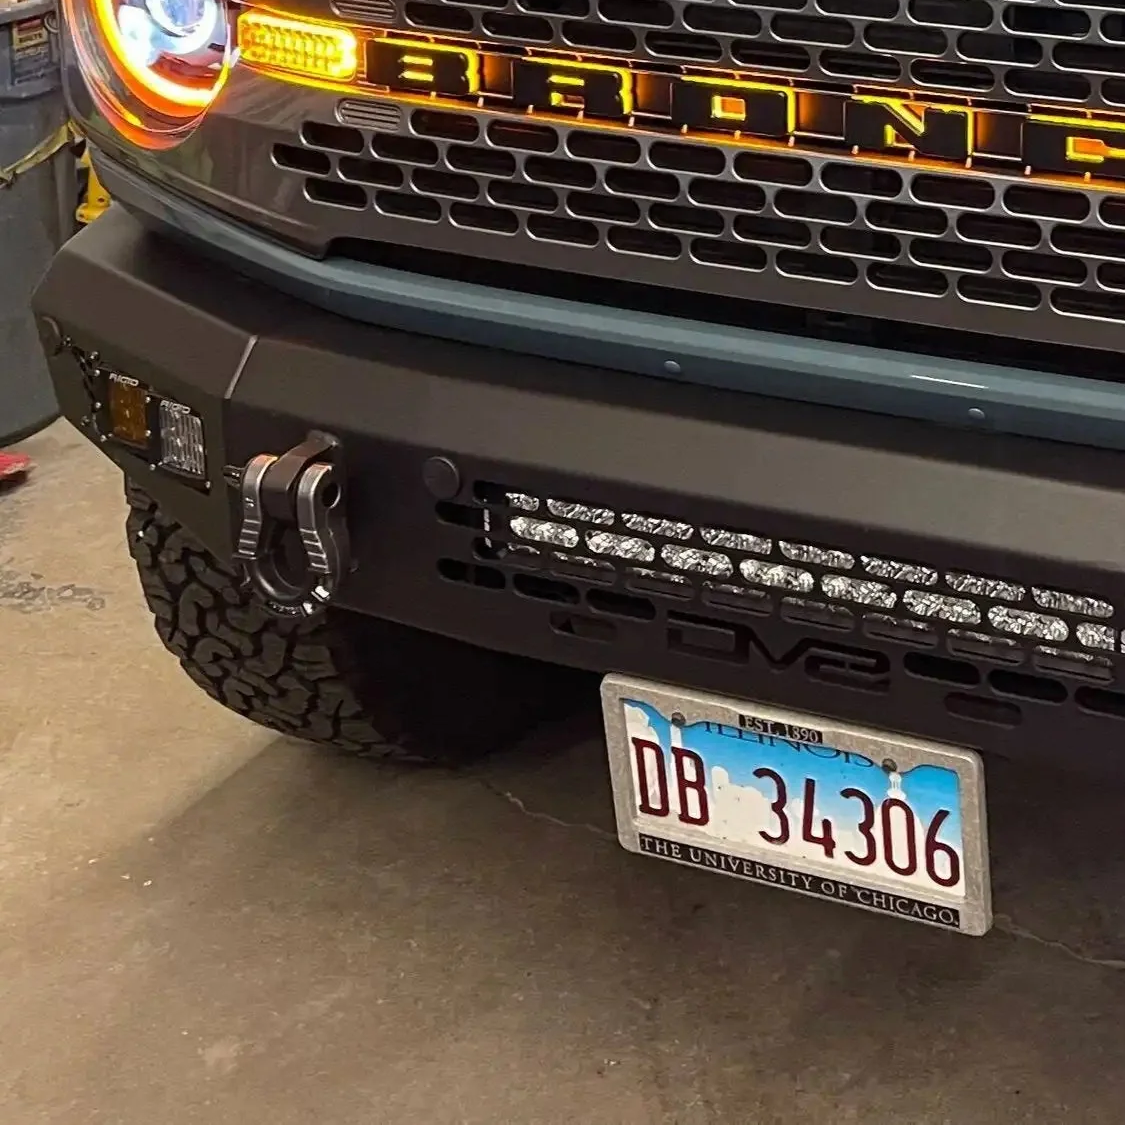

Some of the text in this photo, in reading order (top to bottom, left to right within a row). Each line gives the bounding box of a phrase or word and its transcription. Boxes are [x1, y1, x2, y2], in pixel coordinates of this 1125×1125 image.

[744, 716, 819, 743] EST. 1890
[631, 736, 960, 887] DB 34306
[641, 836, 682, 858] THE
[689, 848, 814, 889] UNIVERSITY
[821, 881, 848, 898] OF
